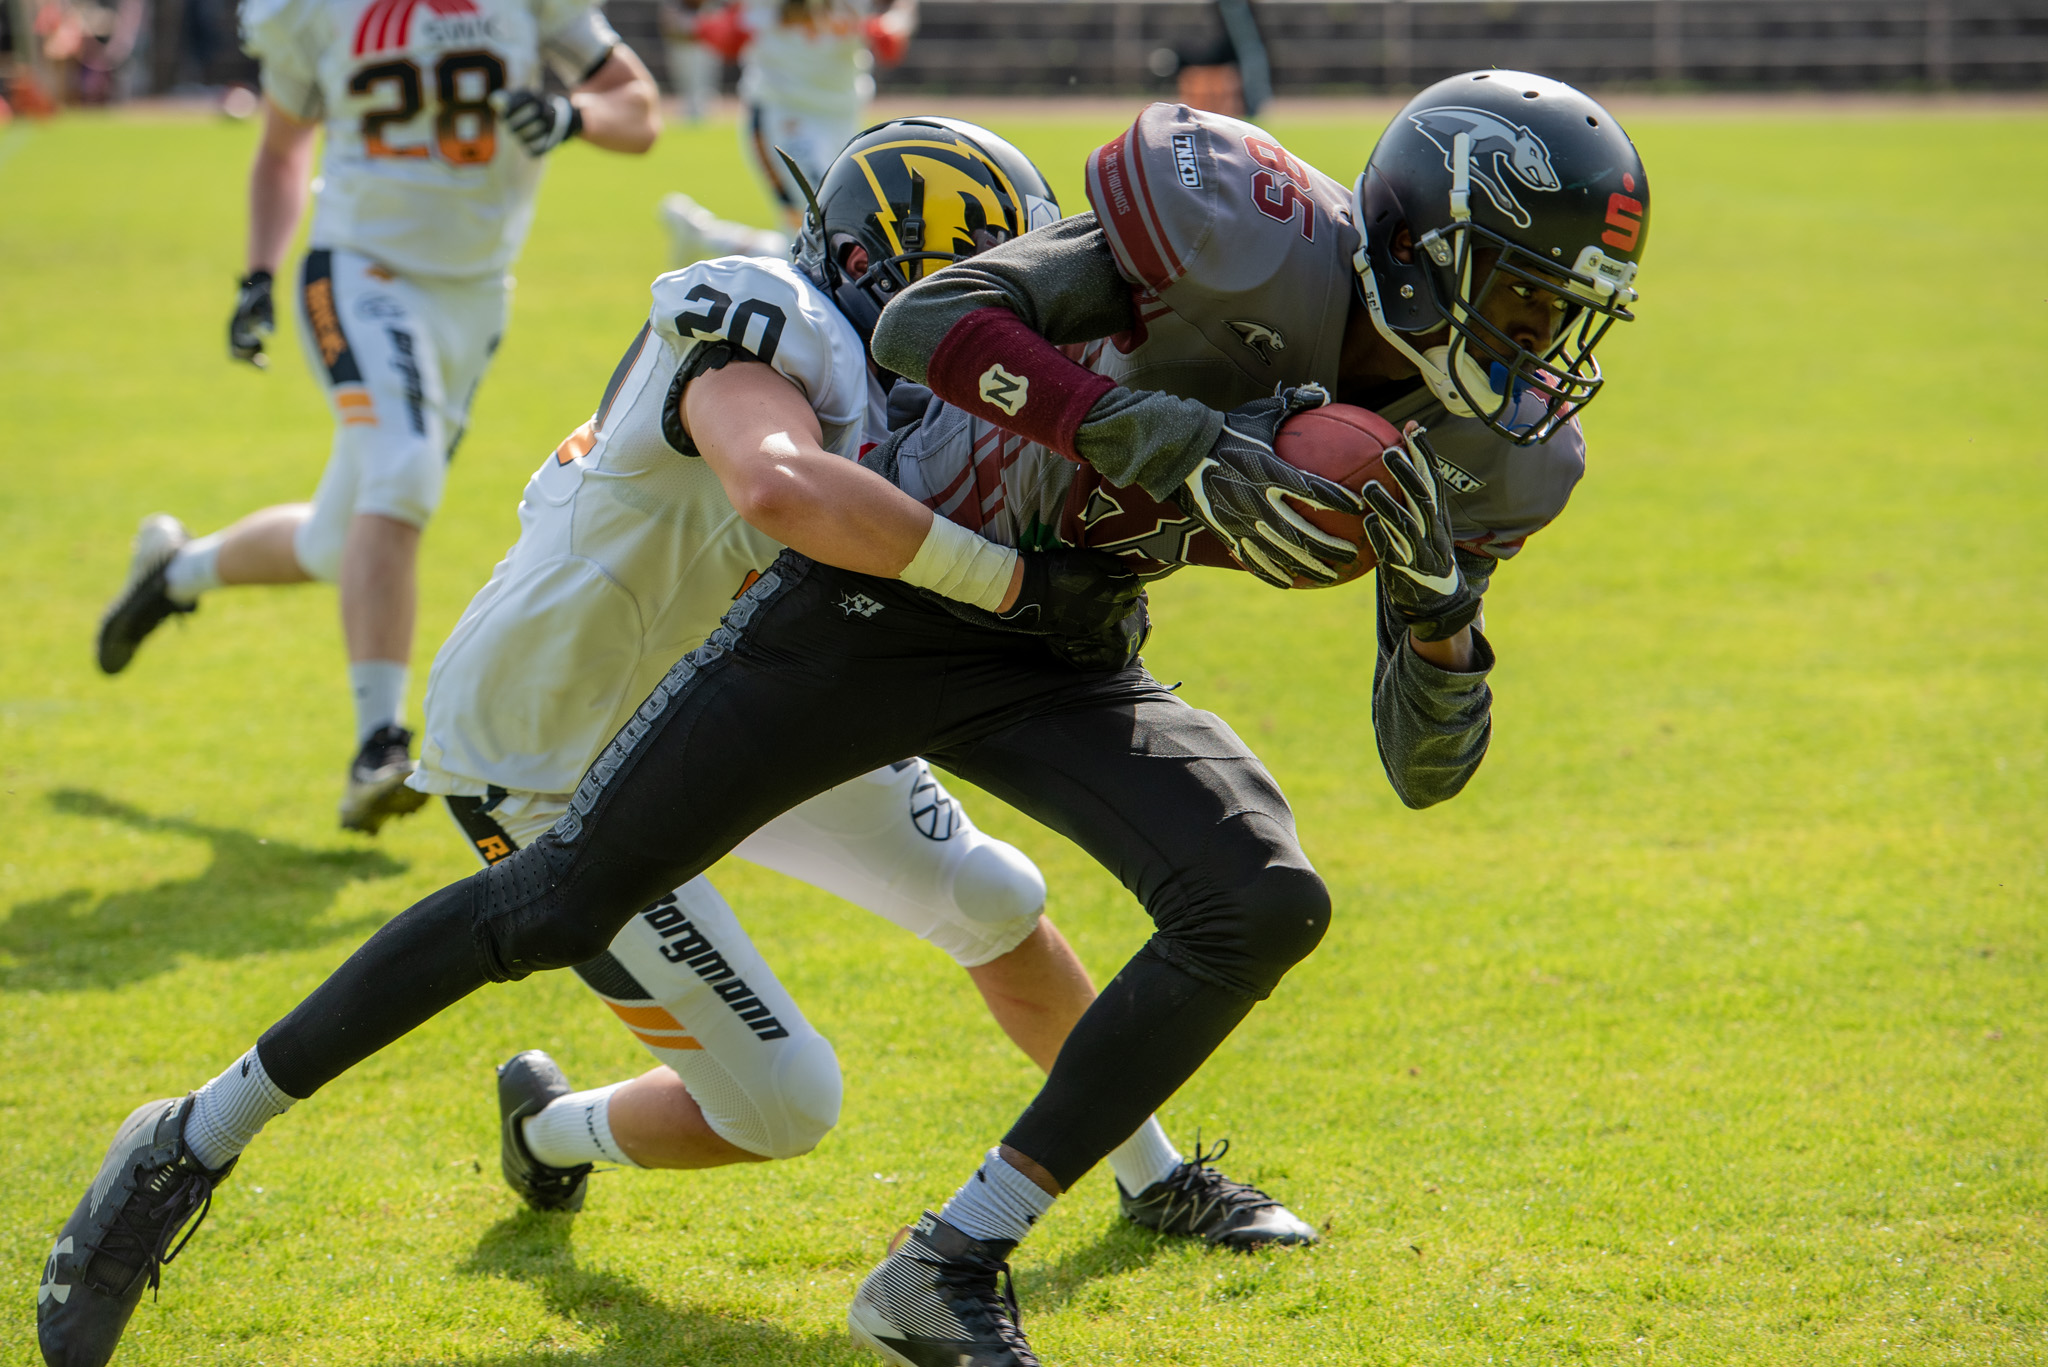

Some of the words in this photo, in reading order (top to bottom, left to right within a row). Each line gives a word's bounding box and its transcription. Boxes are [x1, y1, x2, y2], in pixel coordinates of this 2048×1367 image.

[350, 50, 506, 165] 28
[1104, 151, 1131, 216] GREYHOUNDS
[1173, 136, 1199, 188] TNKD
[1241, 133, 1317, 244] 85
[674, 283, 787, 364] 20
[555, 570, 782, 844] GREYHOUNDS
[476, 834, 515, 866] R
